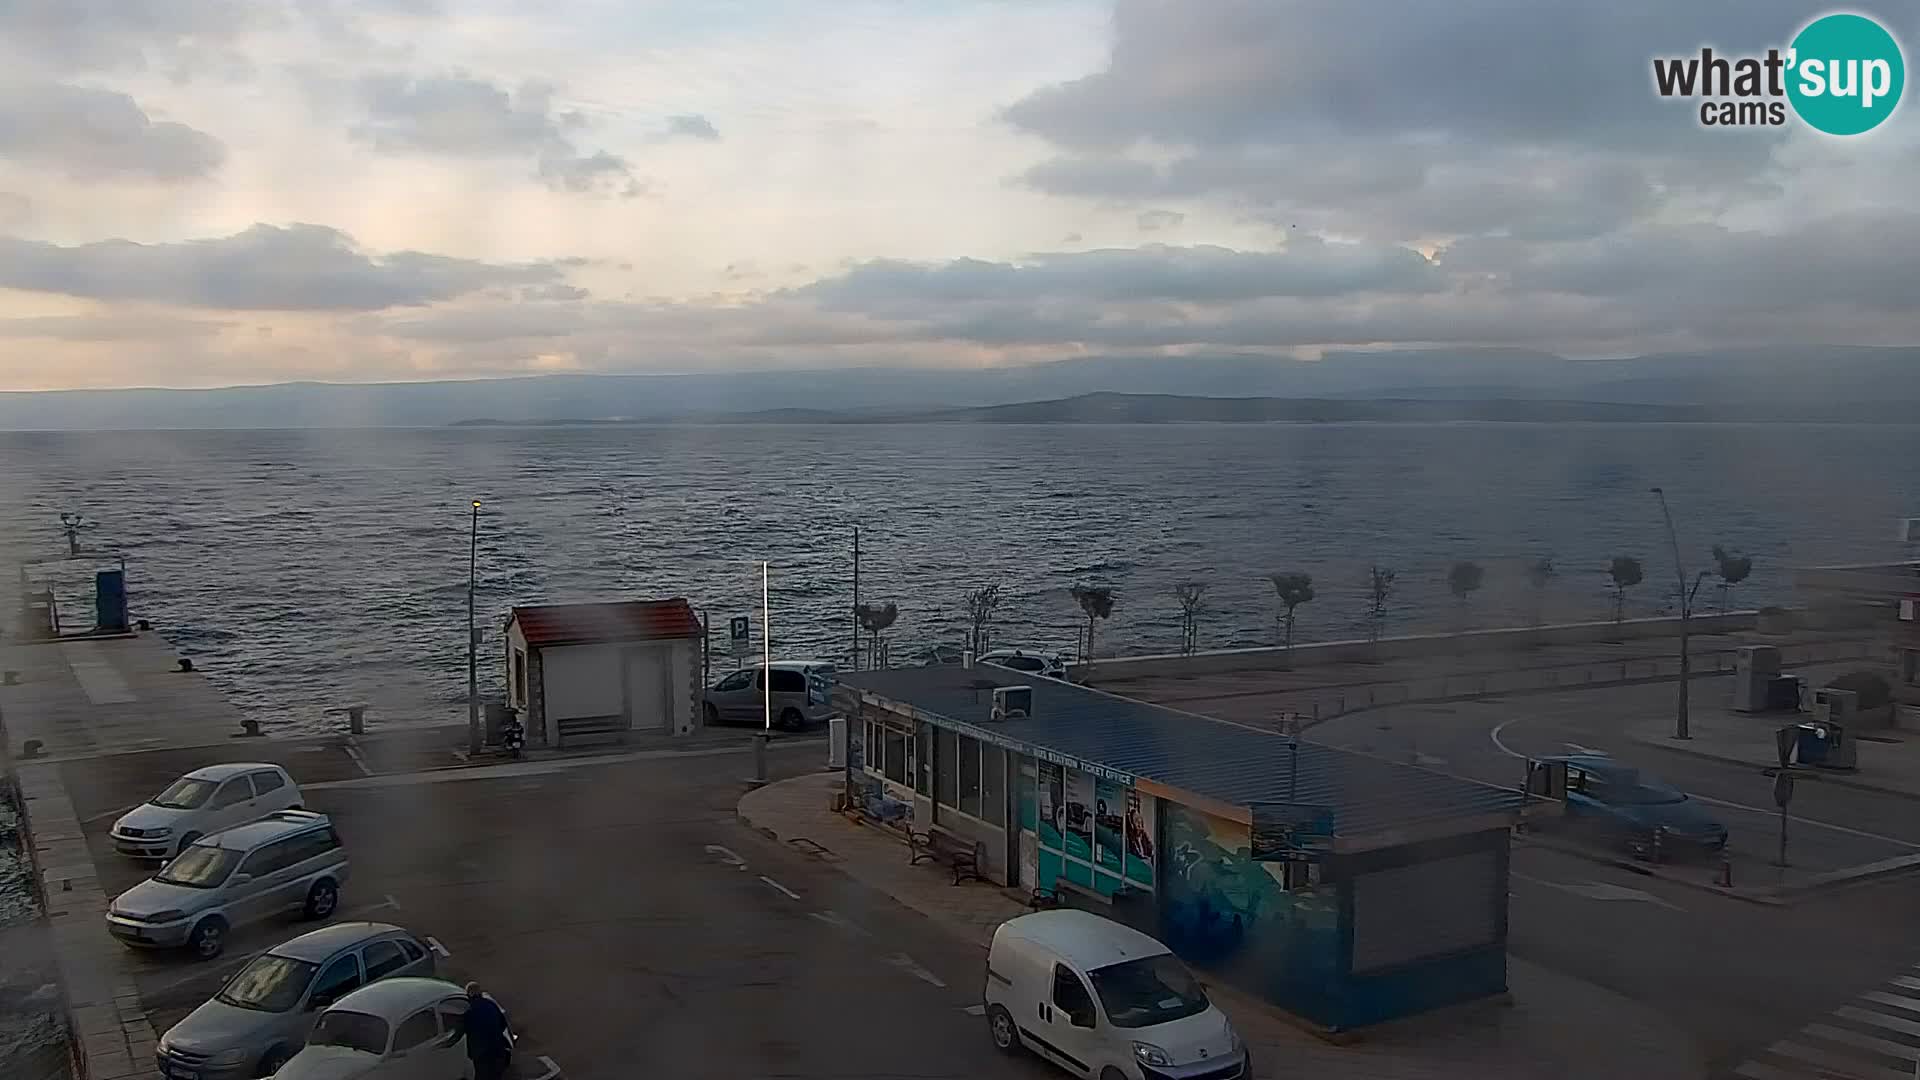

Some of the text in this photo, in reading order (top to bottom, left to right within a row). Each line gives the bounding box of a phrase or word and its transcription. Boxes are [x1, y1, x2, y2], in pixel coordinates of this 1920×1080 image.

[735, 620, 745, 637] P
[1048, 752, 1078, 768] STATION
[1080, 762, 1105, 777] TICKET
[1105, 770, 1131, 785] OFFICE
